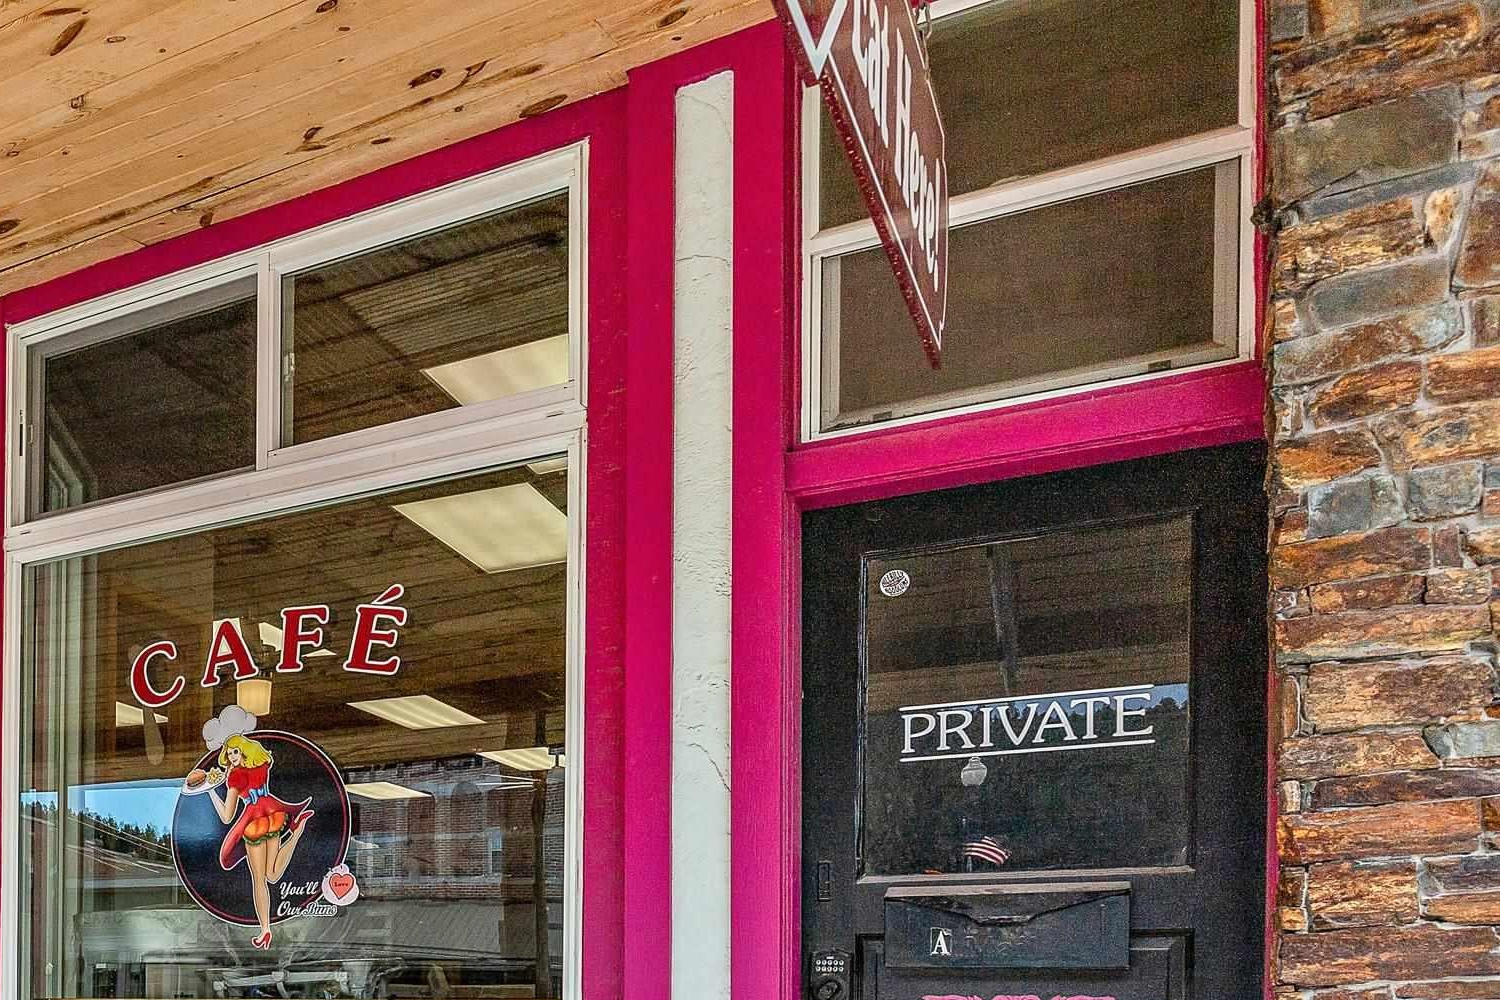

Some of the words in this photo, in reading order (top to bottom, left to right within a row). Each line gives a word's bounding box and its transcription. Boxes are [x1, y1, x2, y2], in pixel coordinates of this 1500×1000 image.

[895, 27, 941, 292] Here!
[130, 583, 408, 707] CAFÉ
[901, 692, 1154, 754] PRIVATE
[277, 900, 301, 917] Our
[301, 901, 338, 917] Buns
[279, 881, 319, 899] You'll
[930, 930, 951, 955] A
